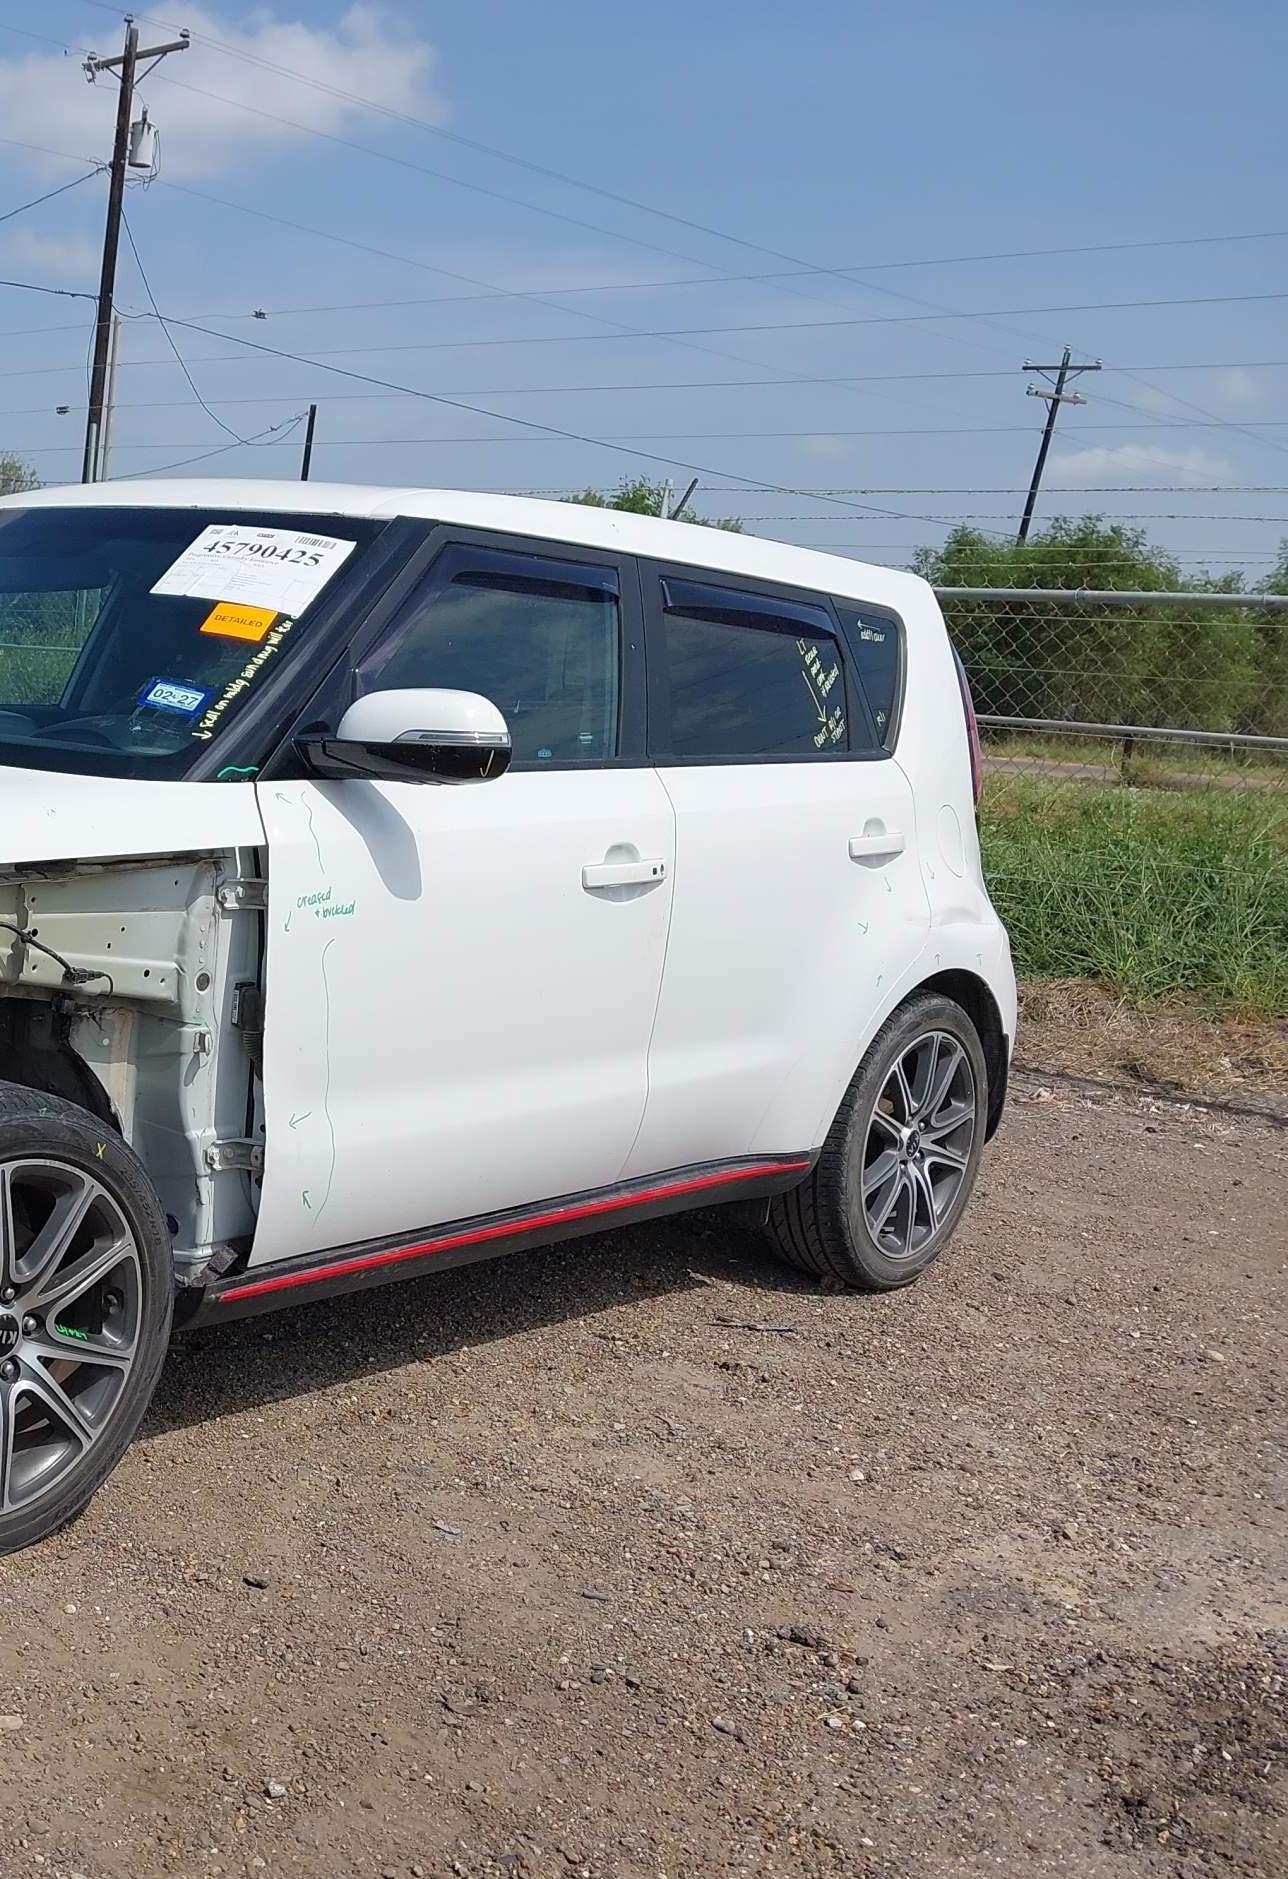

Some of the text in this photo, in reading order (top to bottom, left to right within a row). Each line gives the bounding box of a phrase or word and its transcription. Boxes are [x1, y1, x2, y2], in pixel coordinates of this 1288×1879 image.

[203, 540, 324, 567] 45790425
[214, 614, 263, 628] DETAILED
[153, 688, 199, 706] 02 27
